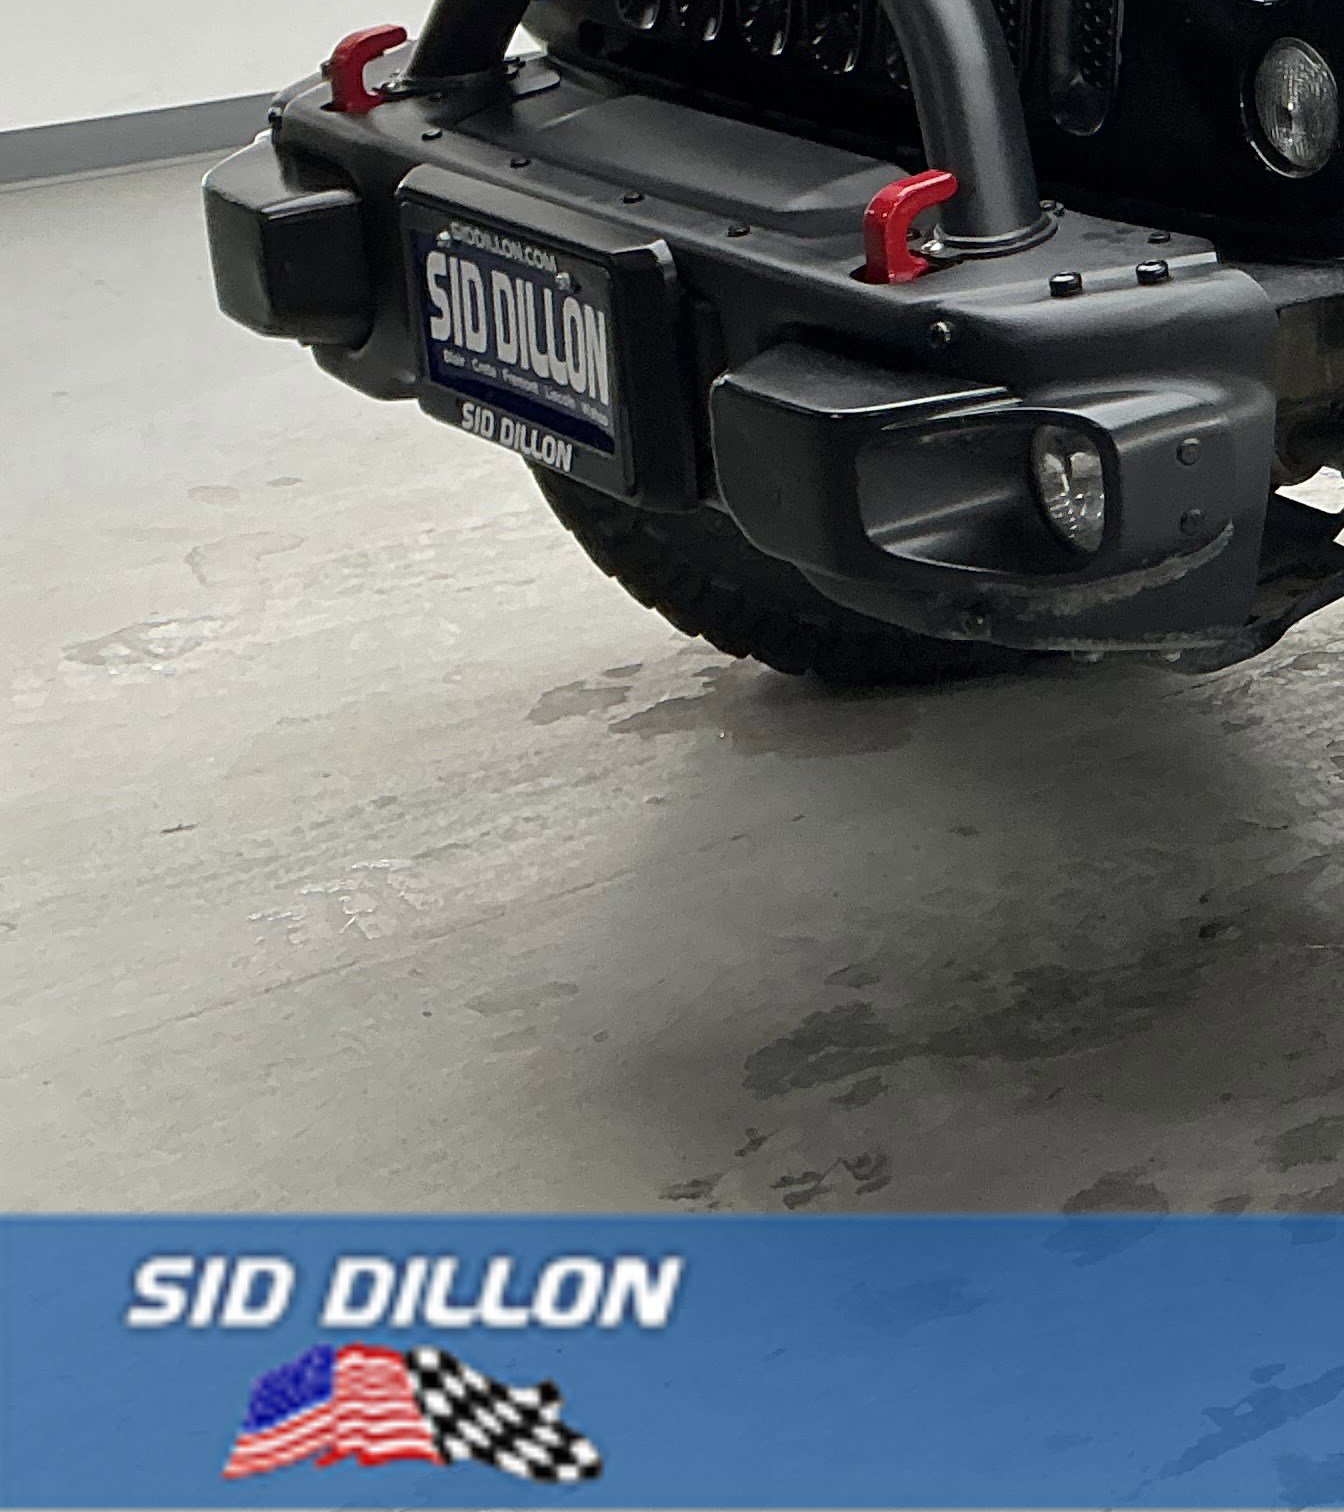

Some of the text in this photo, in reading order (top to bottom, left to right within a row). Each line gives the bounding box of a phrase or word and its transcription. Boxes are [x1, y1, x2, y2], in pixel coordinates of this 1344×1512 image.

[426, 250, 609, 406] SID DILLON
[461, 401, 573, 472] SID DILLON
